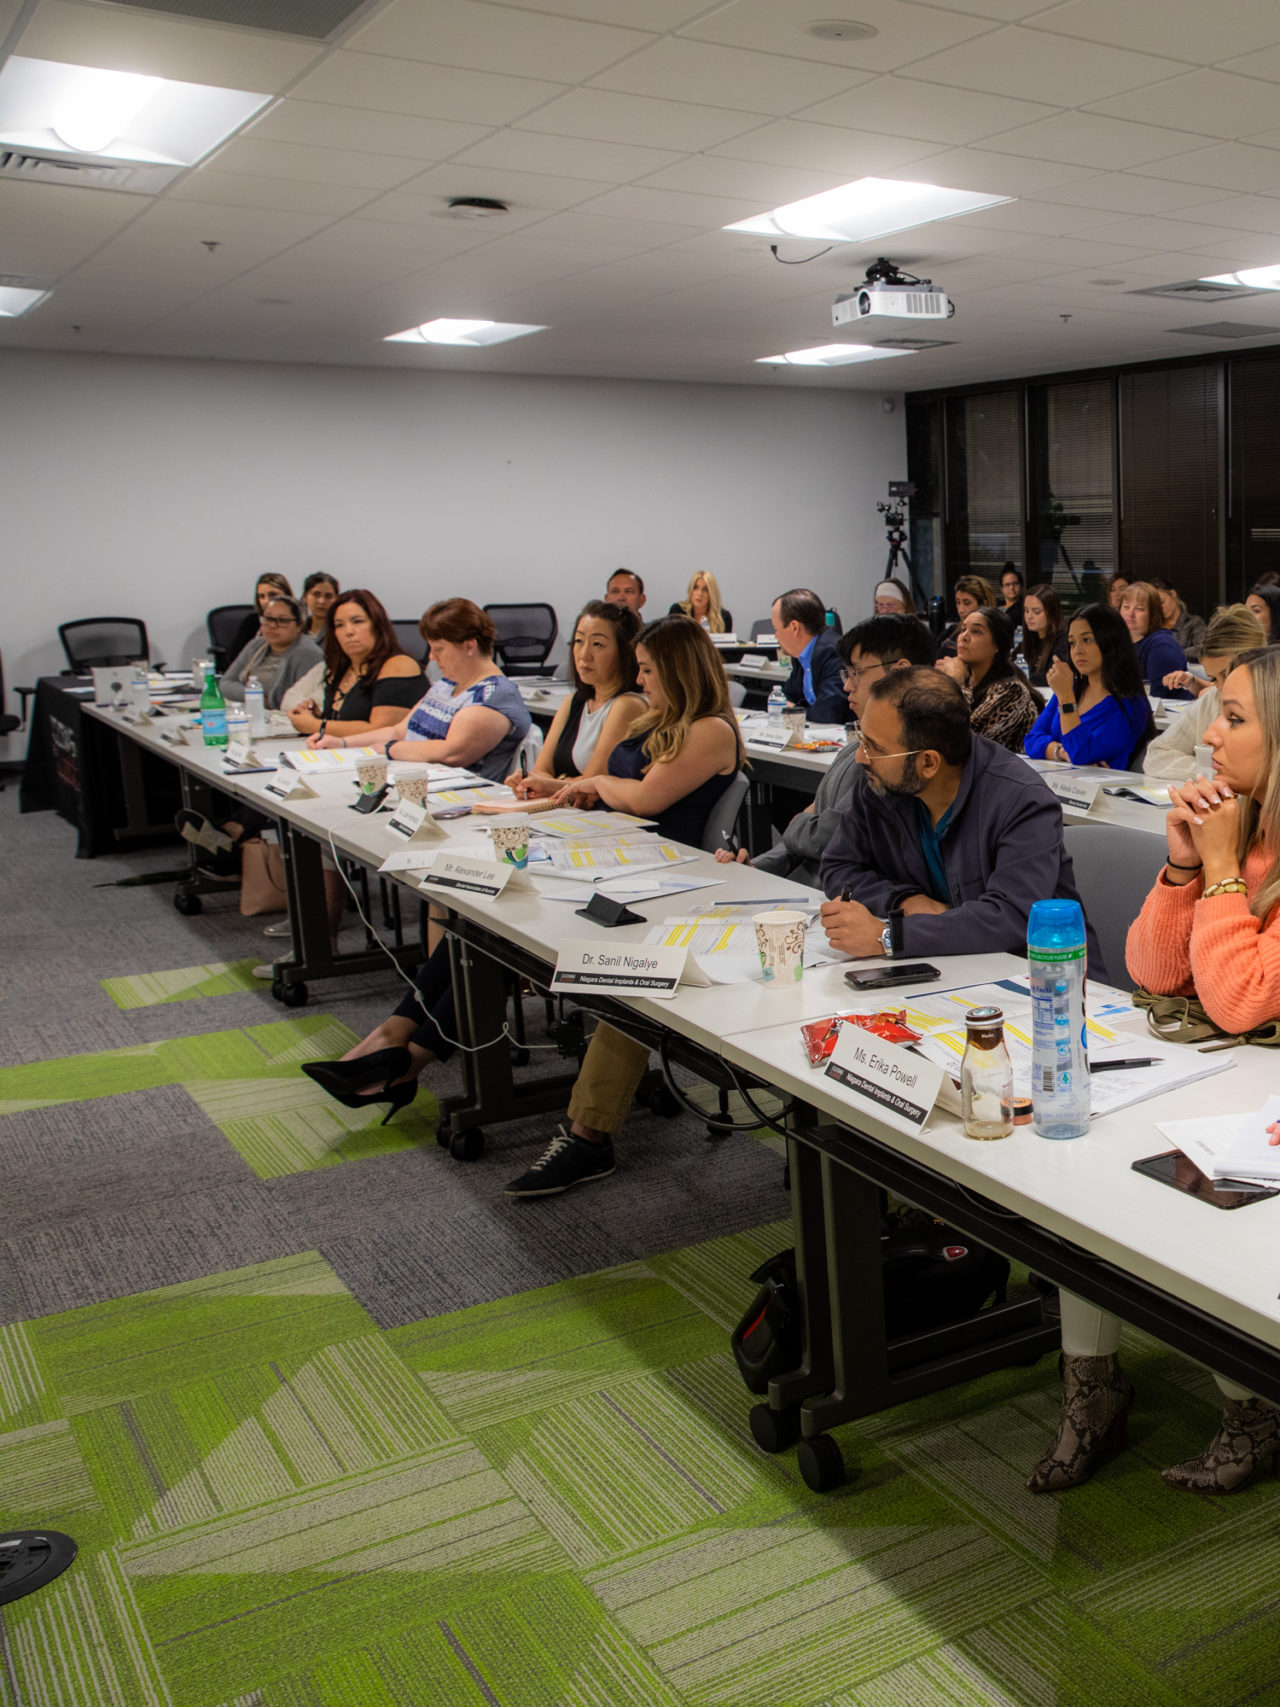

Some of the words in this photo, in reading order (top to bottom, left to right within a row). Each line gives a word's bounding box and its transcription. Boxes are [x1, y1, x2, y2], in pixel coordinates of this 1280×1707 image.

[582, 953, 595, 965] Dr.
[597, 954, 622, 966] Sanil
[623, 956, 659, 971] Nigalye
[579, 975, 599, 984] Niagara
[599, 976, 614, 984] Dental
[614, 977, 634, 986] Implants
[639, 979, 650, 987] Oral
[650, 980, 670, 989] Surgery
[853, 1046, 867, 1065] Ms.
[868, 1054, 888, 1076] Erika
[889, 1064, 919, 1089] Powell
[845, 1072, 861, 1088] Niagara
[861, 1079, 874, 1094] Dental
[874, 1086, 892, 1103] Implants
[894, 1097, 905, 1109] Oral
[904, 1102, 922, 1119] Surgery
